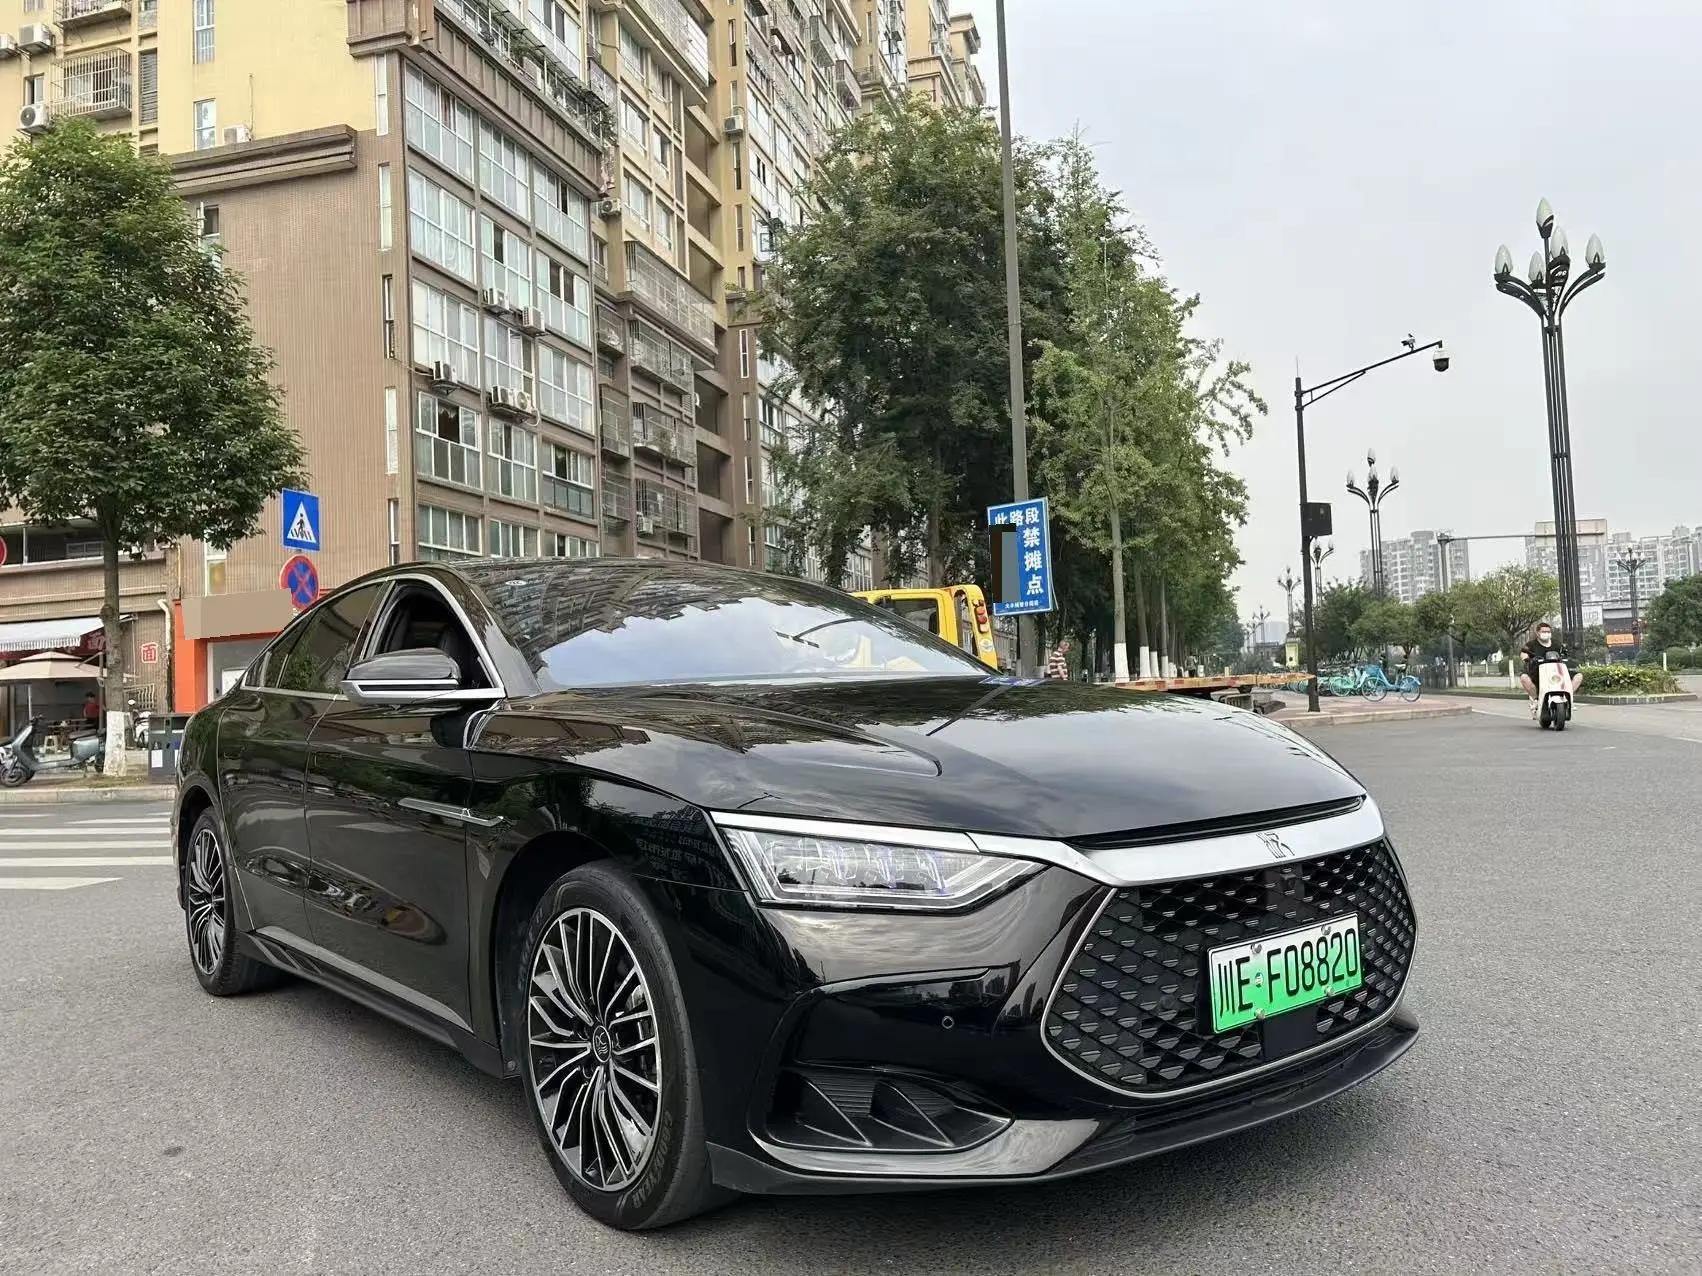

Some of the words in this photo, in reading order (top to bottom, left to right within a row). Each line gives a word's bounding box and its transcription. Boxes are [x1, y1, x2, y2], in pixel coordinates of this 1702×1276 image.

[1023, 527, 1044, 596] 禁摊点
[142, 643, 158, 663] 面
[1266, 927, 1358, 1004] F08820
